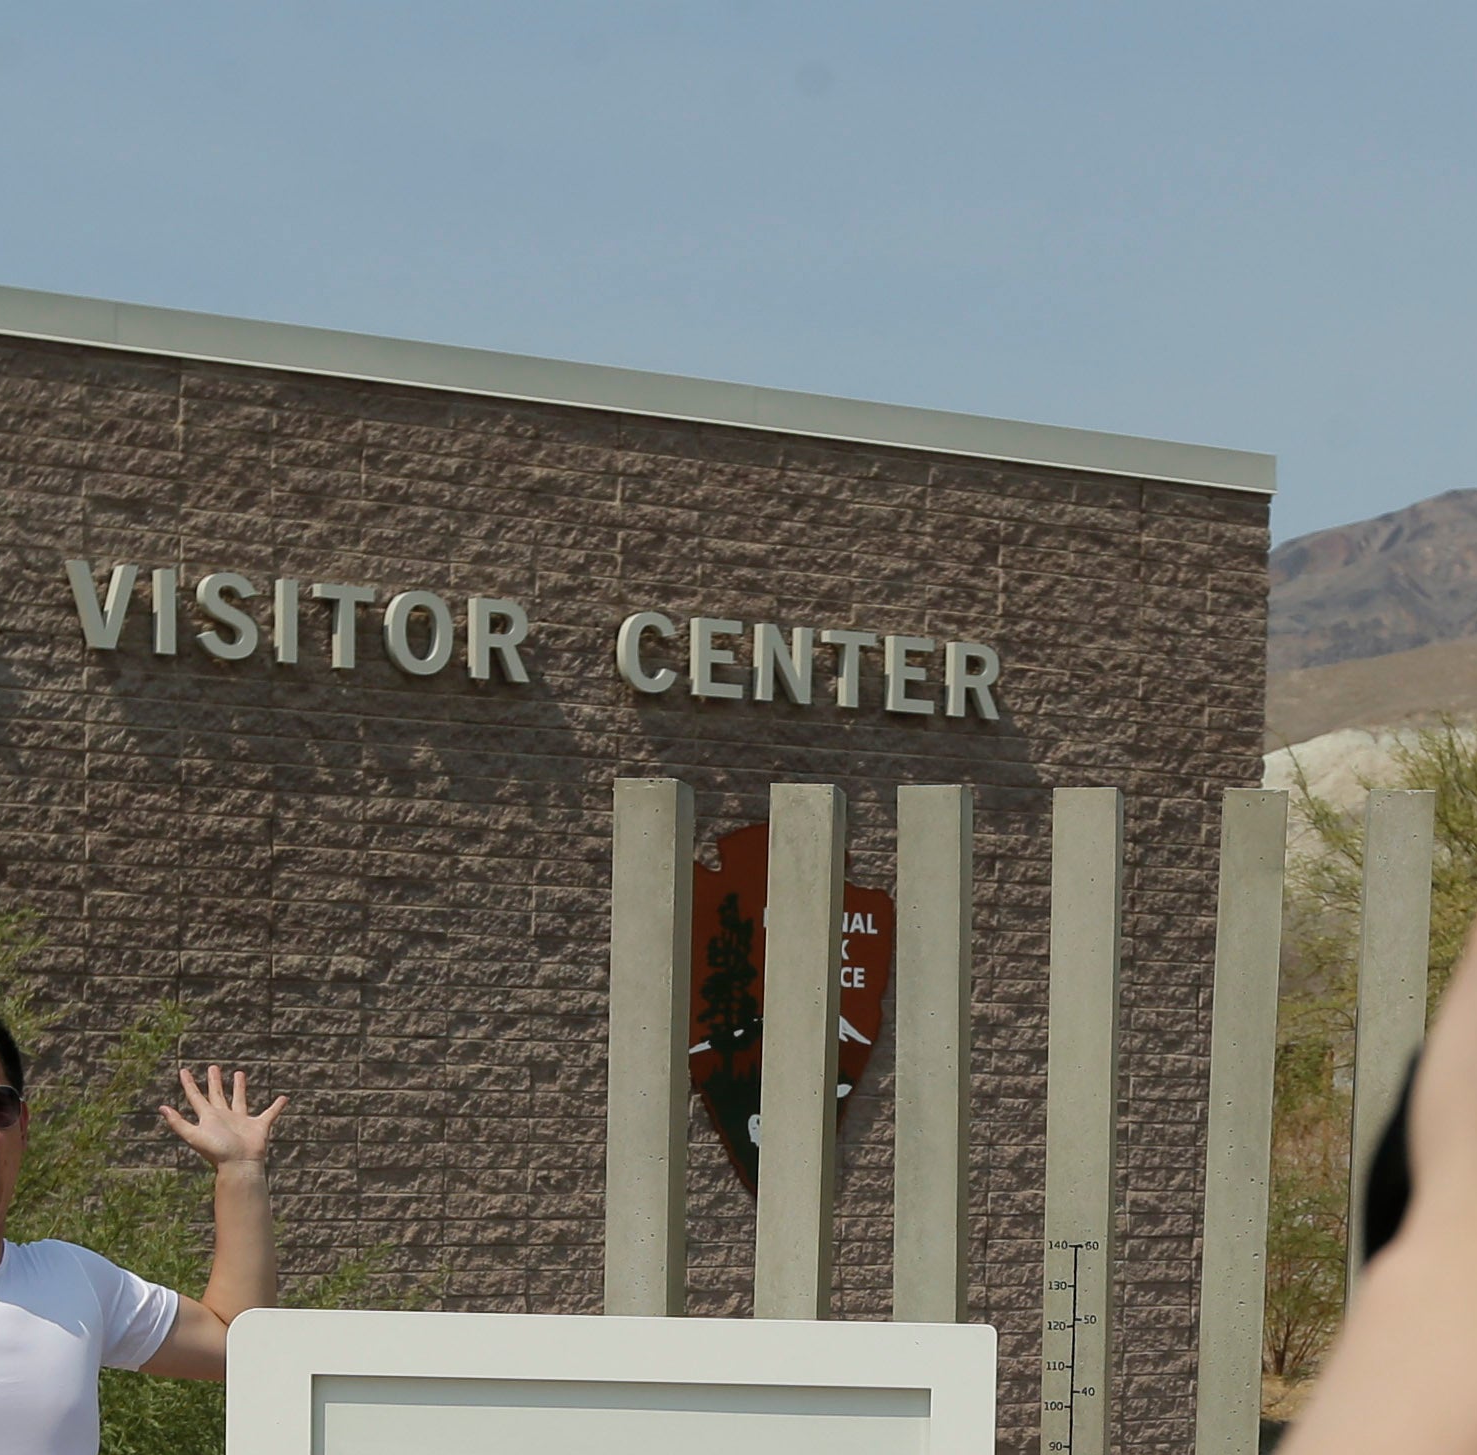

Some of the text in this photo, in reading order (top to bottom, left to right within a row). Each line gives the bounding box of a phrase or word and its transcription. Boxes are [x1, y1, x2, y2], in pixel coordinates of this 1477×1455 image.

[65, 559, 529, 684] VISITOR
[615, 612, 1001, 721] CENTER
[1048, 1240, 1068, 1250] 140
[1048, 1281, 1068, 1291] 130
[1083, 1315, 1097, 1325] 50
[1047, 1321, 1066, 1331] 120
[1046, 1361, 1065, 1371] 110
[1081, 1387, 1095, 1397] 40
[1044, 1401, 1064, 1411] 100
[1049, 1442, 1063, 1452] 90
